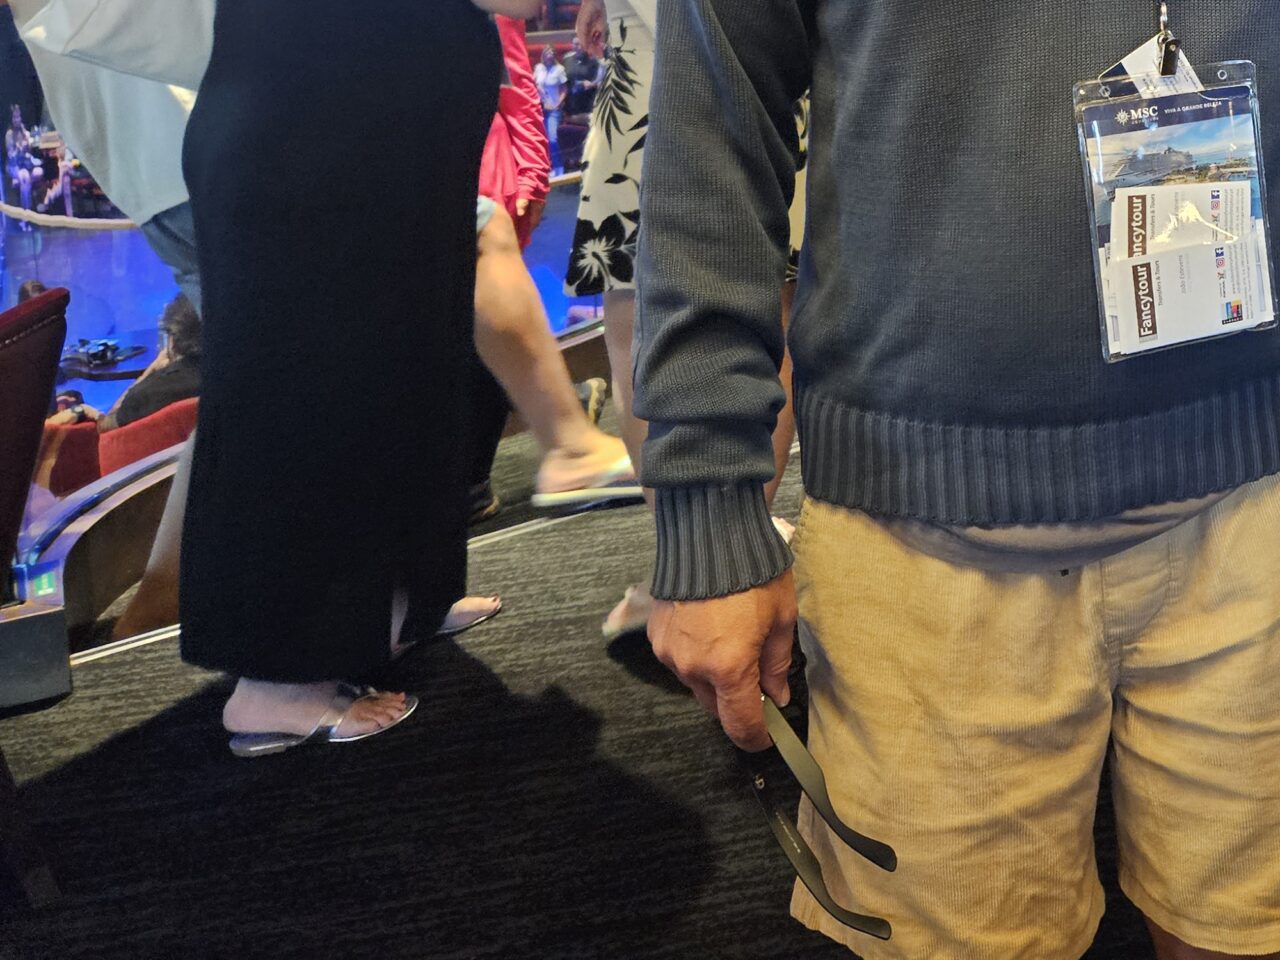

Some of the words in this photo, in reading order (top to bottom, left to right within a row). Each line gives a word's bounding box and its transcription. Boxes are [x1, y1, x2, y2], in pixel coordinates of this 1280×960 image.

[1130, 106, 1158, 120] MSC
[1132, 197, 1146, 258] ancytour
[1138, 266, 1153, 336] Fancytour
